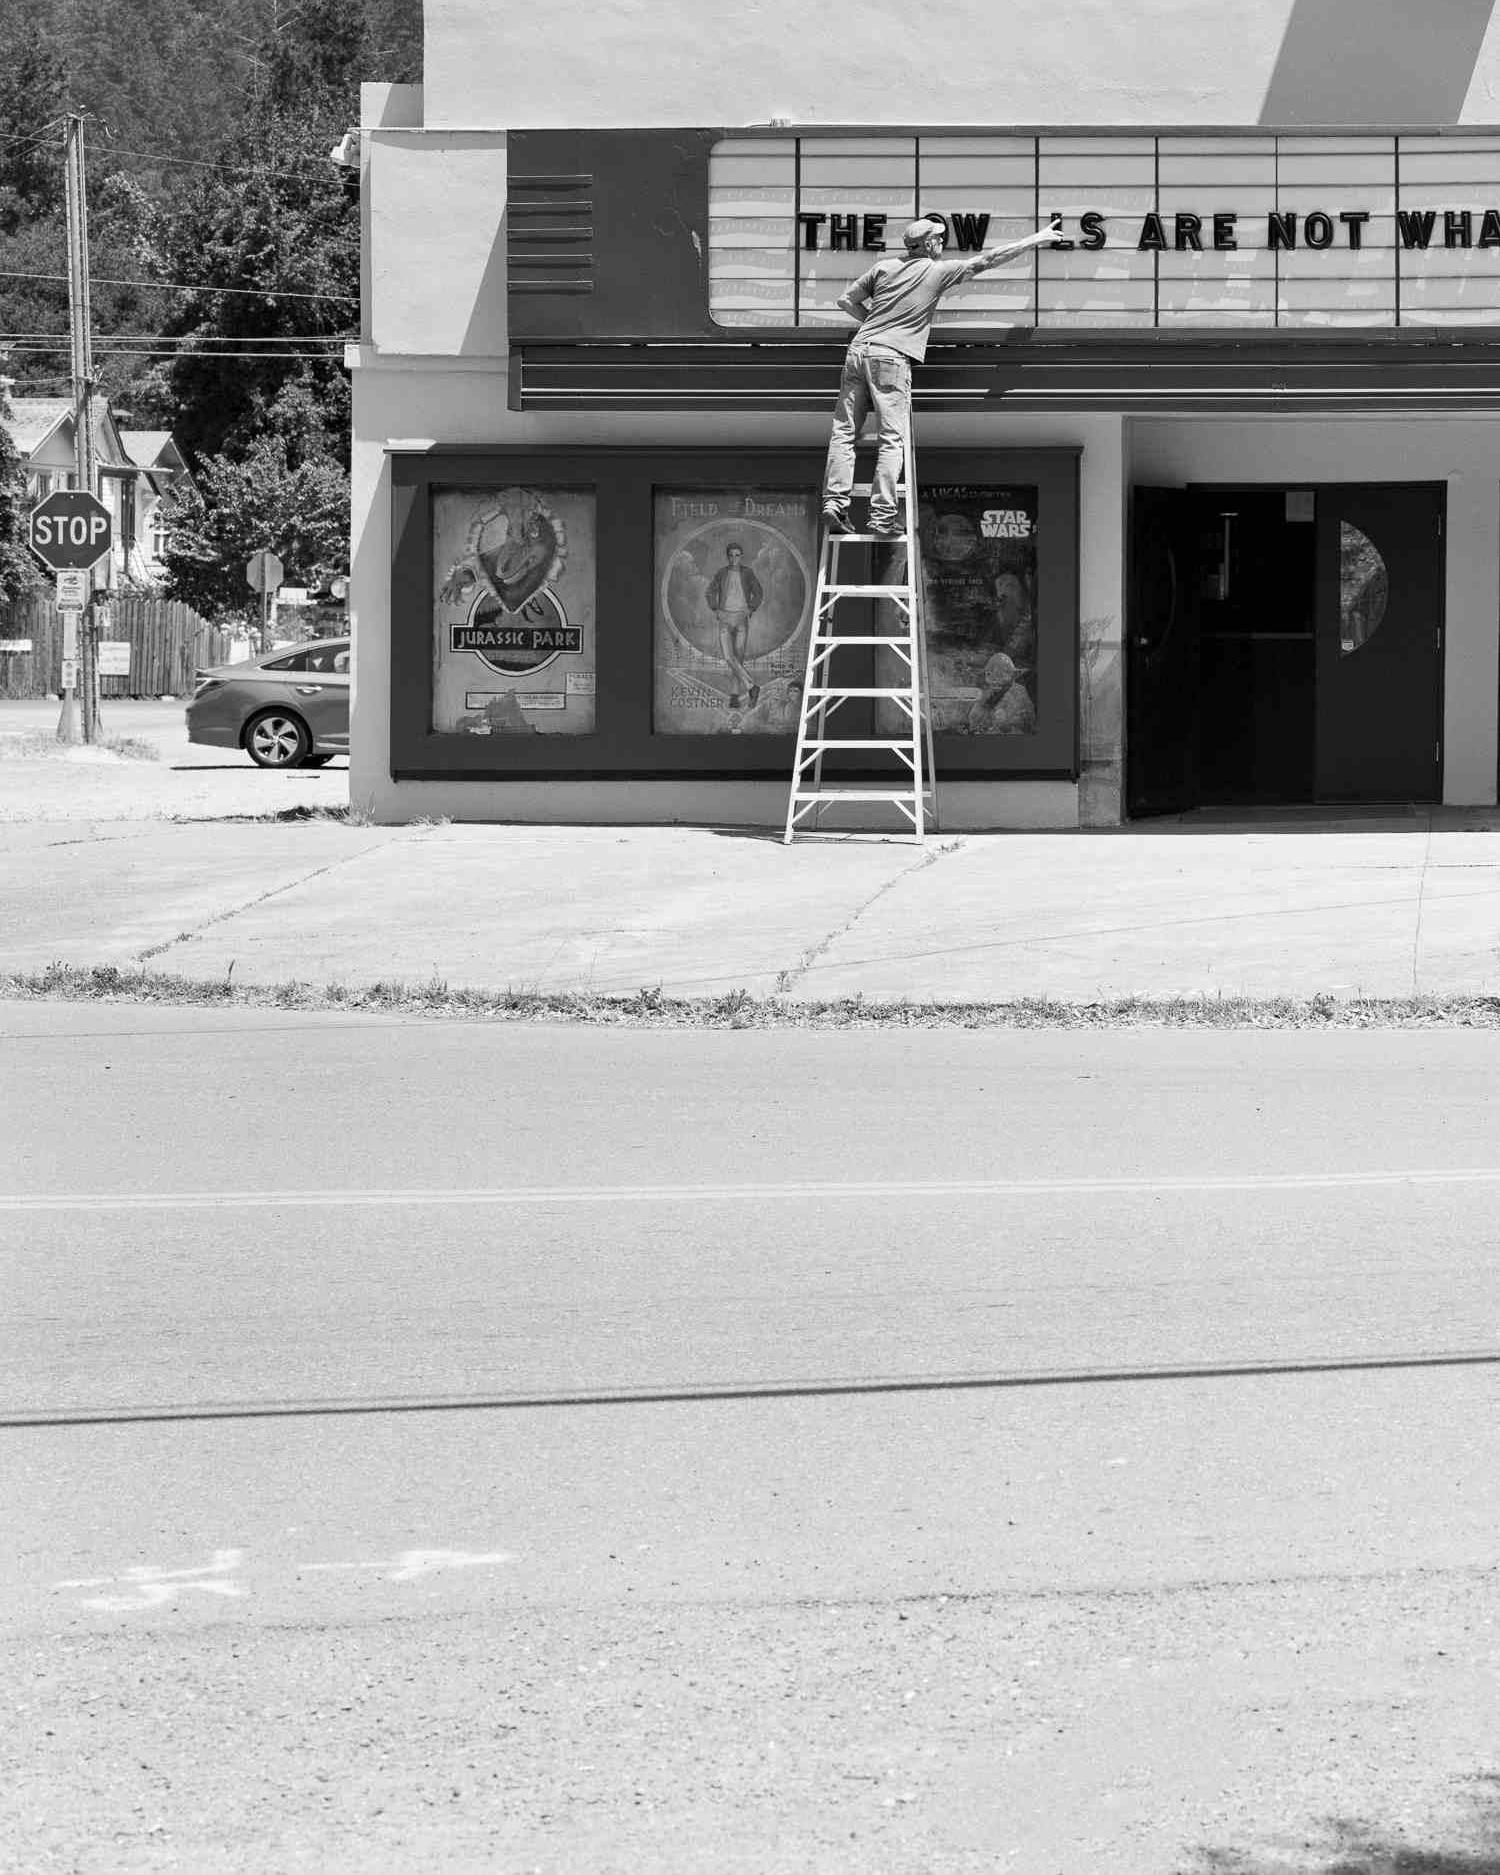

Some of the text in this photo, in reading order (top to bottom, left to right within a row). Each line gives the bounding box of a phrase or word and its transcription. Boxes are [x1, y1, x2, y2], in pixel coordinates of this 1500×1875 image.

[799, 213, 888, 251] THE
[1138, 212, 1238, 251] ARE
[1268, 211, 1370, 251] NOT
[980, 509, 1031, 525] STAR
[35, 515, 108, 545] STOP
[980, 524, 1031, 538] WARS
[458, 629, 577, 648] JURASSIC PARK
[671, 685, 713, 697] KEVIN
[671, 698, 723, 709] COSTNER
